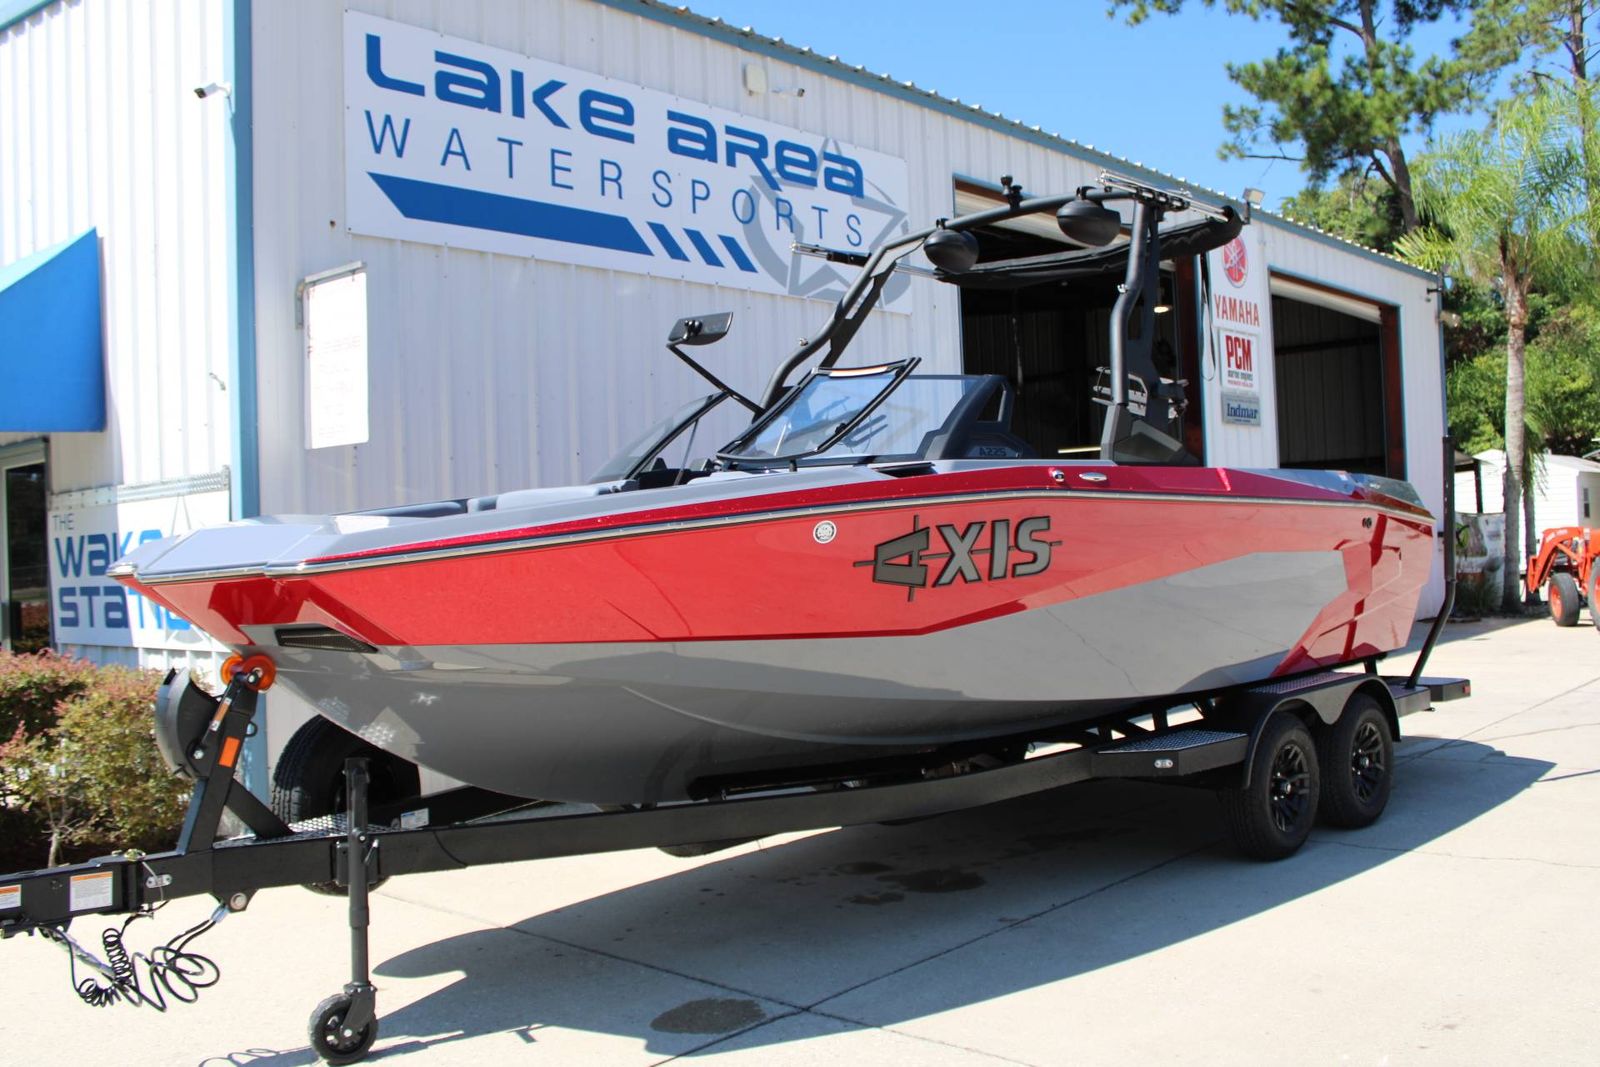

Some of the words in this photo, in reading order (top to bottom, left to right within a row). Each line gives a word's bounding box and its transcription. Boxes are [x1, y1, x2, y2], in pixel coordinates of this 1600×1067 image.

[365, 110, 863, 247] WATERSPORTS
[1214, 294, 1260, 327] YAMAHA
[1225, 335, 1252, 372] PCM
[1227, 402, 1258, 420] Indmar
[52, 513, 75, 531] THE
[872, 515, 1052, 588] AXIS
